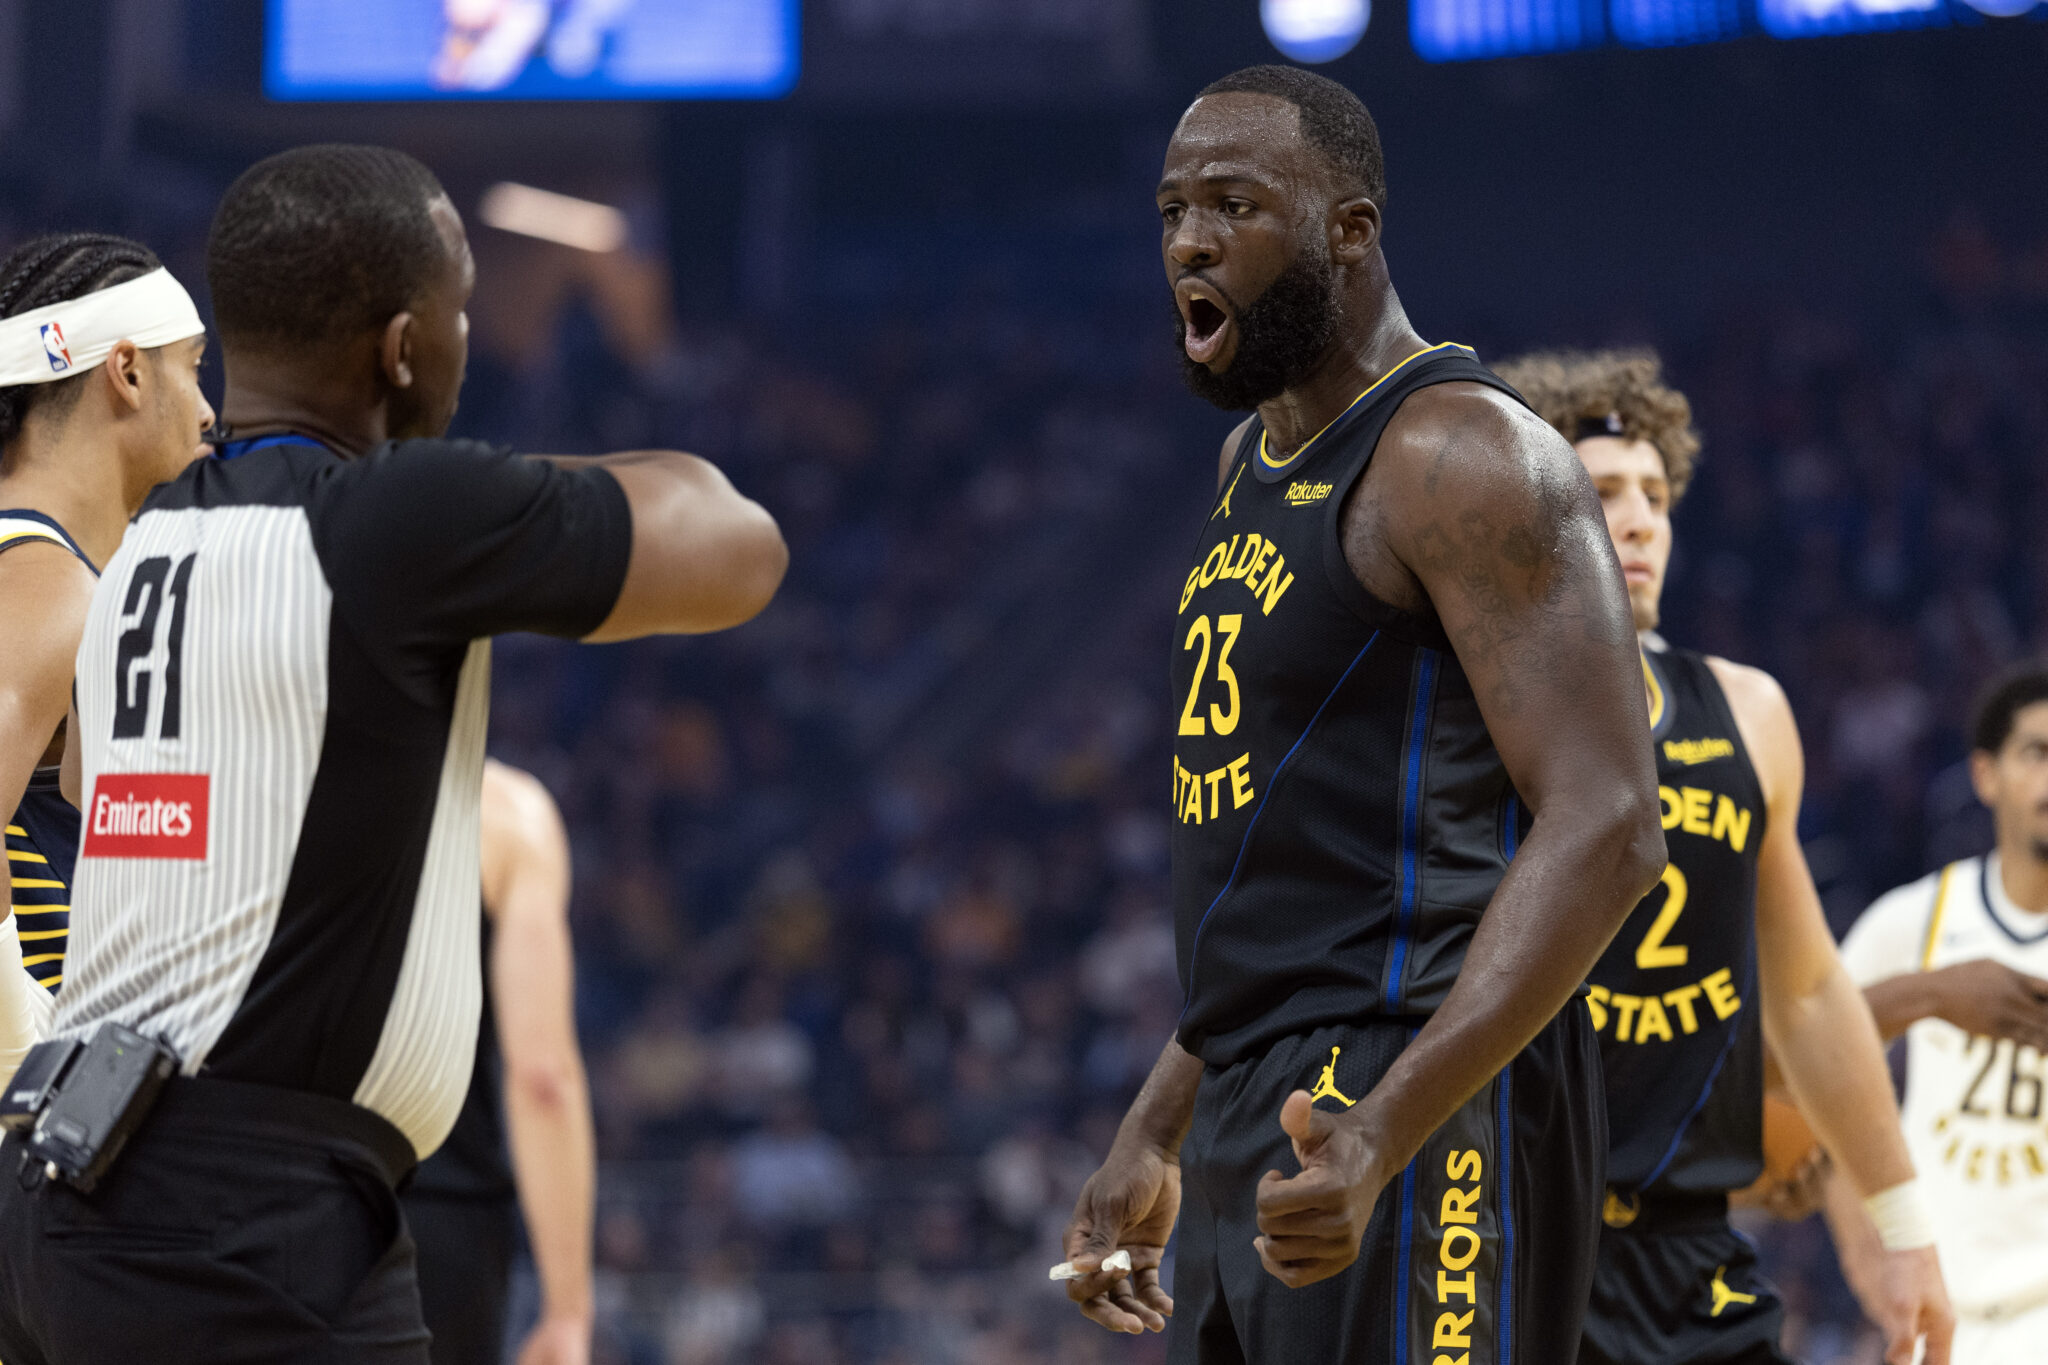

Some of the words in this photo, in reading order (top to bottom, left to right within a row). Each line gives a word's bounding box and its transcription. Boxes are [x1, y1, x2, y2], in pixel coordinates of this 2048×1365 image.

[1284, 480, 1333, 500] Rakuten
[1178, 533, 1295, 616] GOLDEN
[111, 552, 197, 739] 21
[1177, 614, 1243, 736] 23
[93, 791, 192, 837] Emirates
[1658, 784, 1752, 853] DEN
[1637, 862, 1688, 969] 2
[1585, 966, 1742, 1045] STATE
[1959, 1036, 2043, 1120] 26
[1431, 1149, 1483, 1365] RIORS
